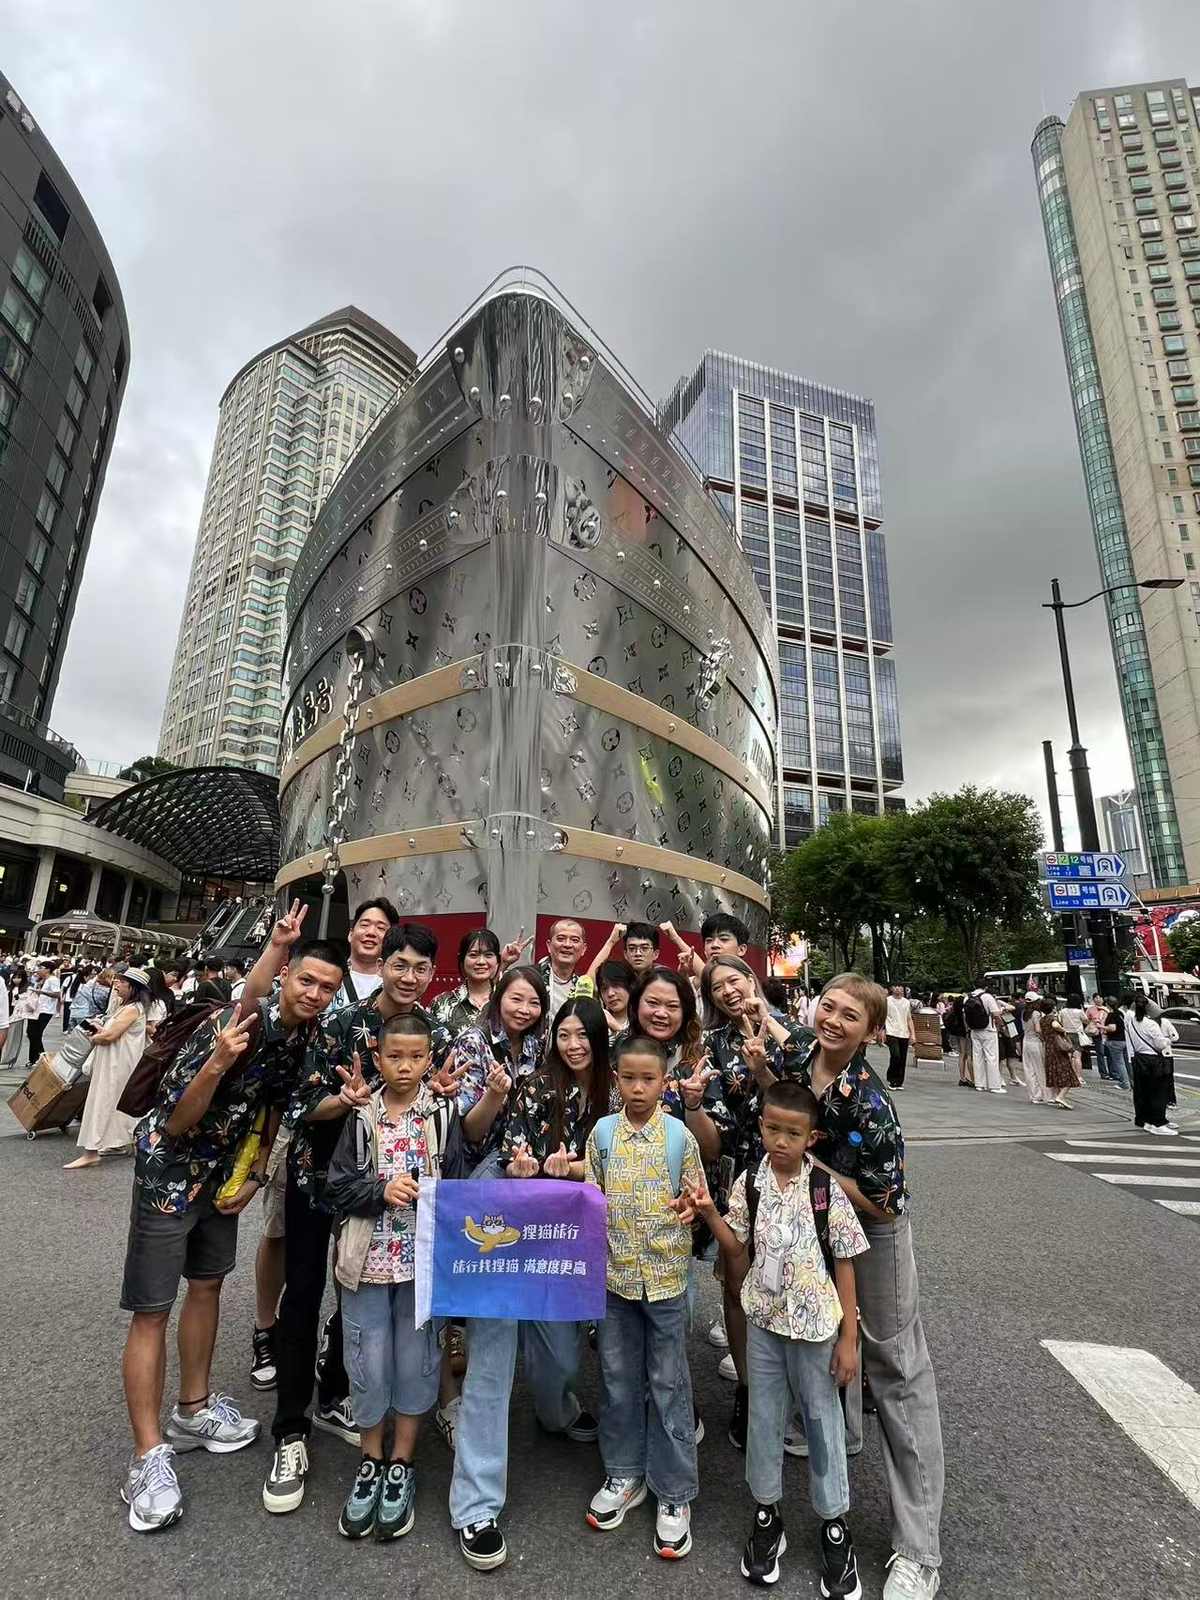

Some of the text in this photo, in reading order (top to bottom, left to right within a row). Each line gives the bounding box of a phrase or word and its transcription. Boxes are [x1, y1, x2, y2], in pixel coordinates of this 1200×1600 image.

[522, 1223, 580, 1240] 狸猫旅行
[452, 1258, 587, 1276] 旅行找狸猫 满意度更高
